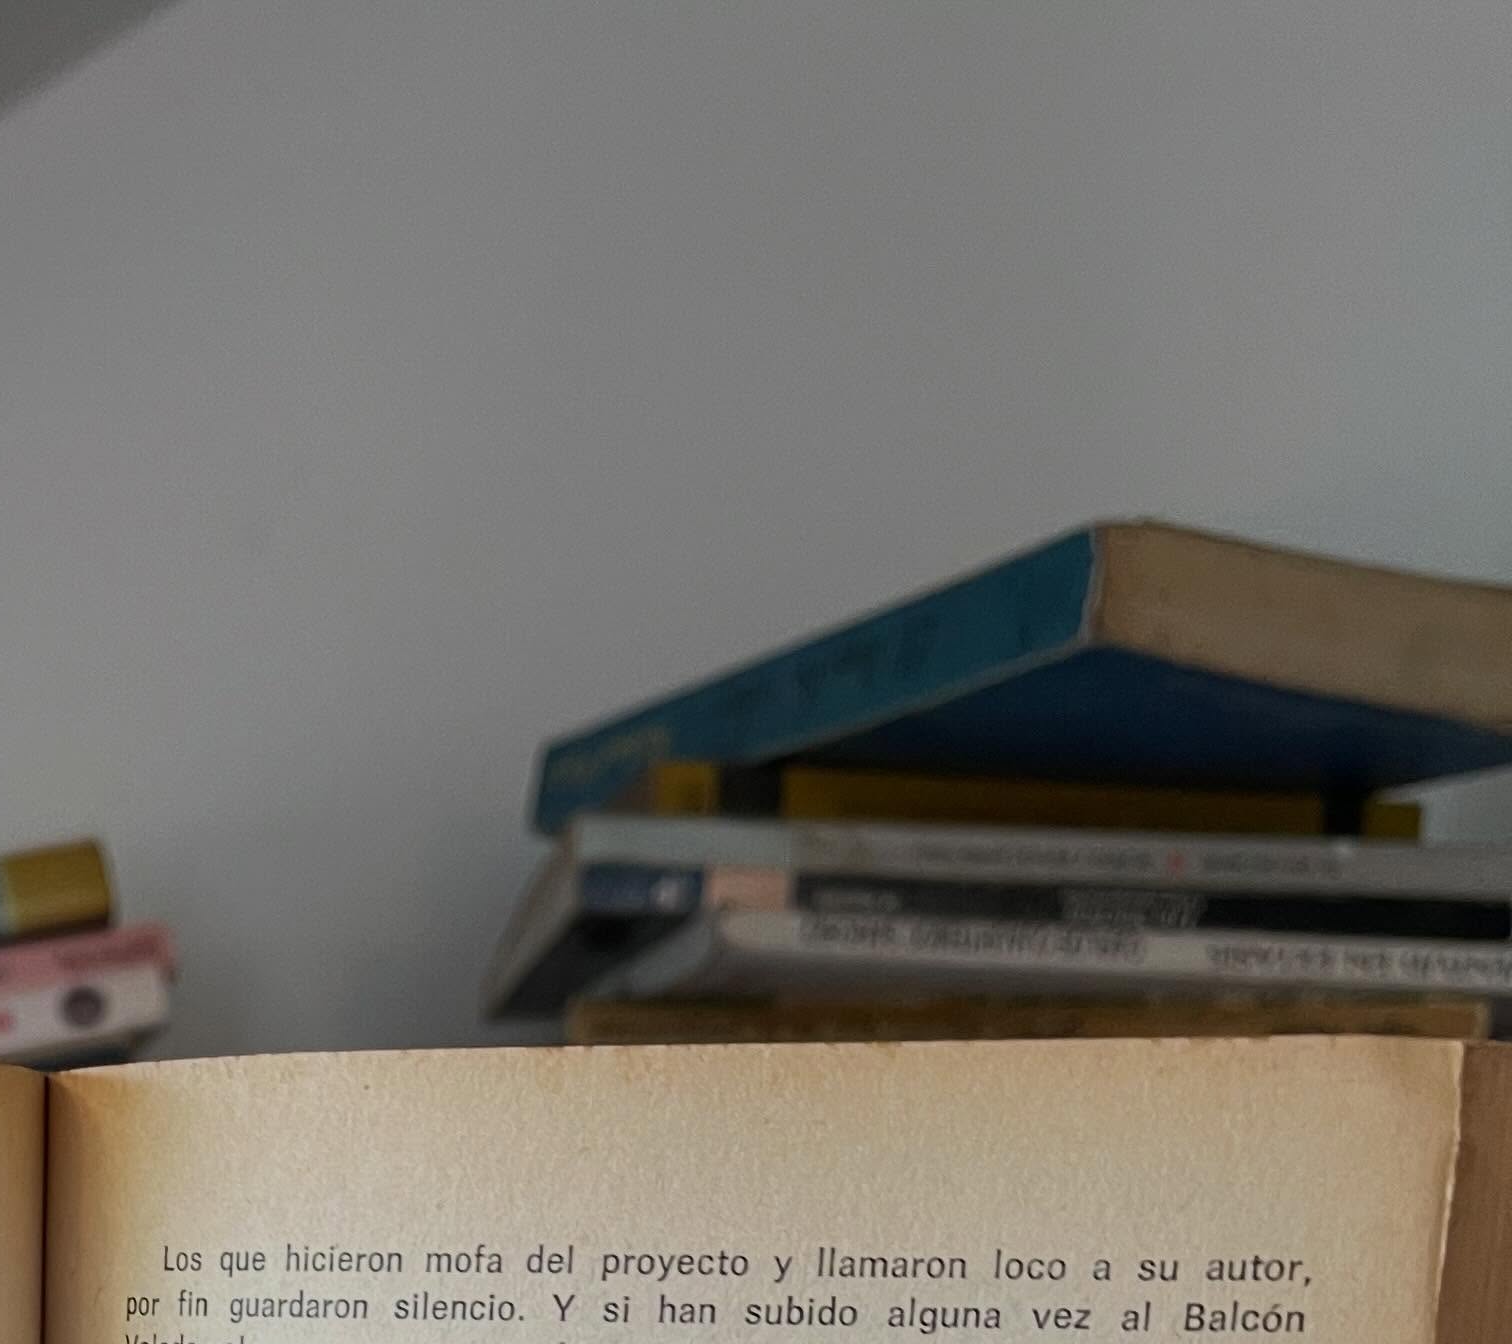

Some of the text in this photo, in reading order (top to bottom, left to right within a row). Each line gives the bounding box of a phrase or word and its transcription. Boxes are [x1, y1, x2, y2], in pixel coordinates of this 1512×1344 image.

[162, 1242, 1312, 1288] Los que hicieron mofa del proyecto y llamaron loco a su autor,
